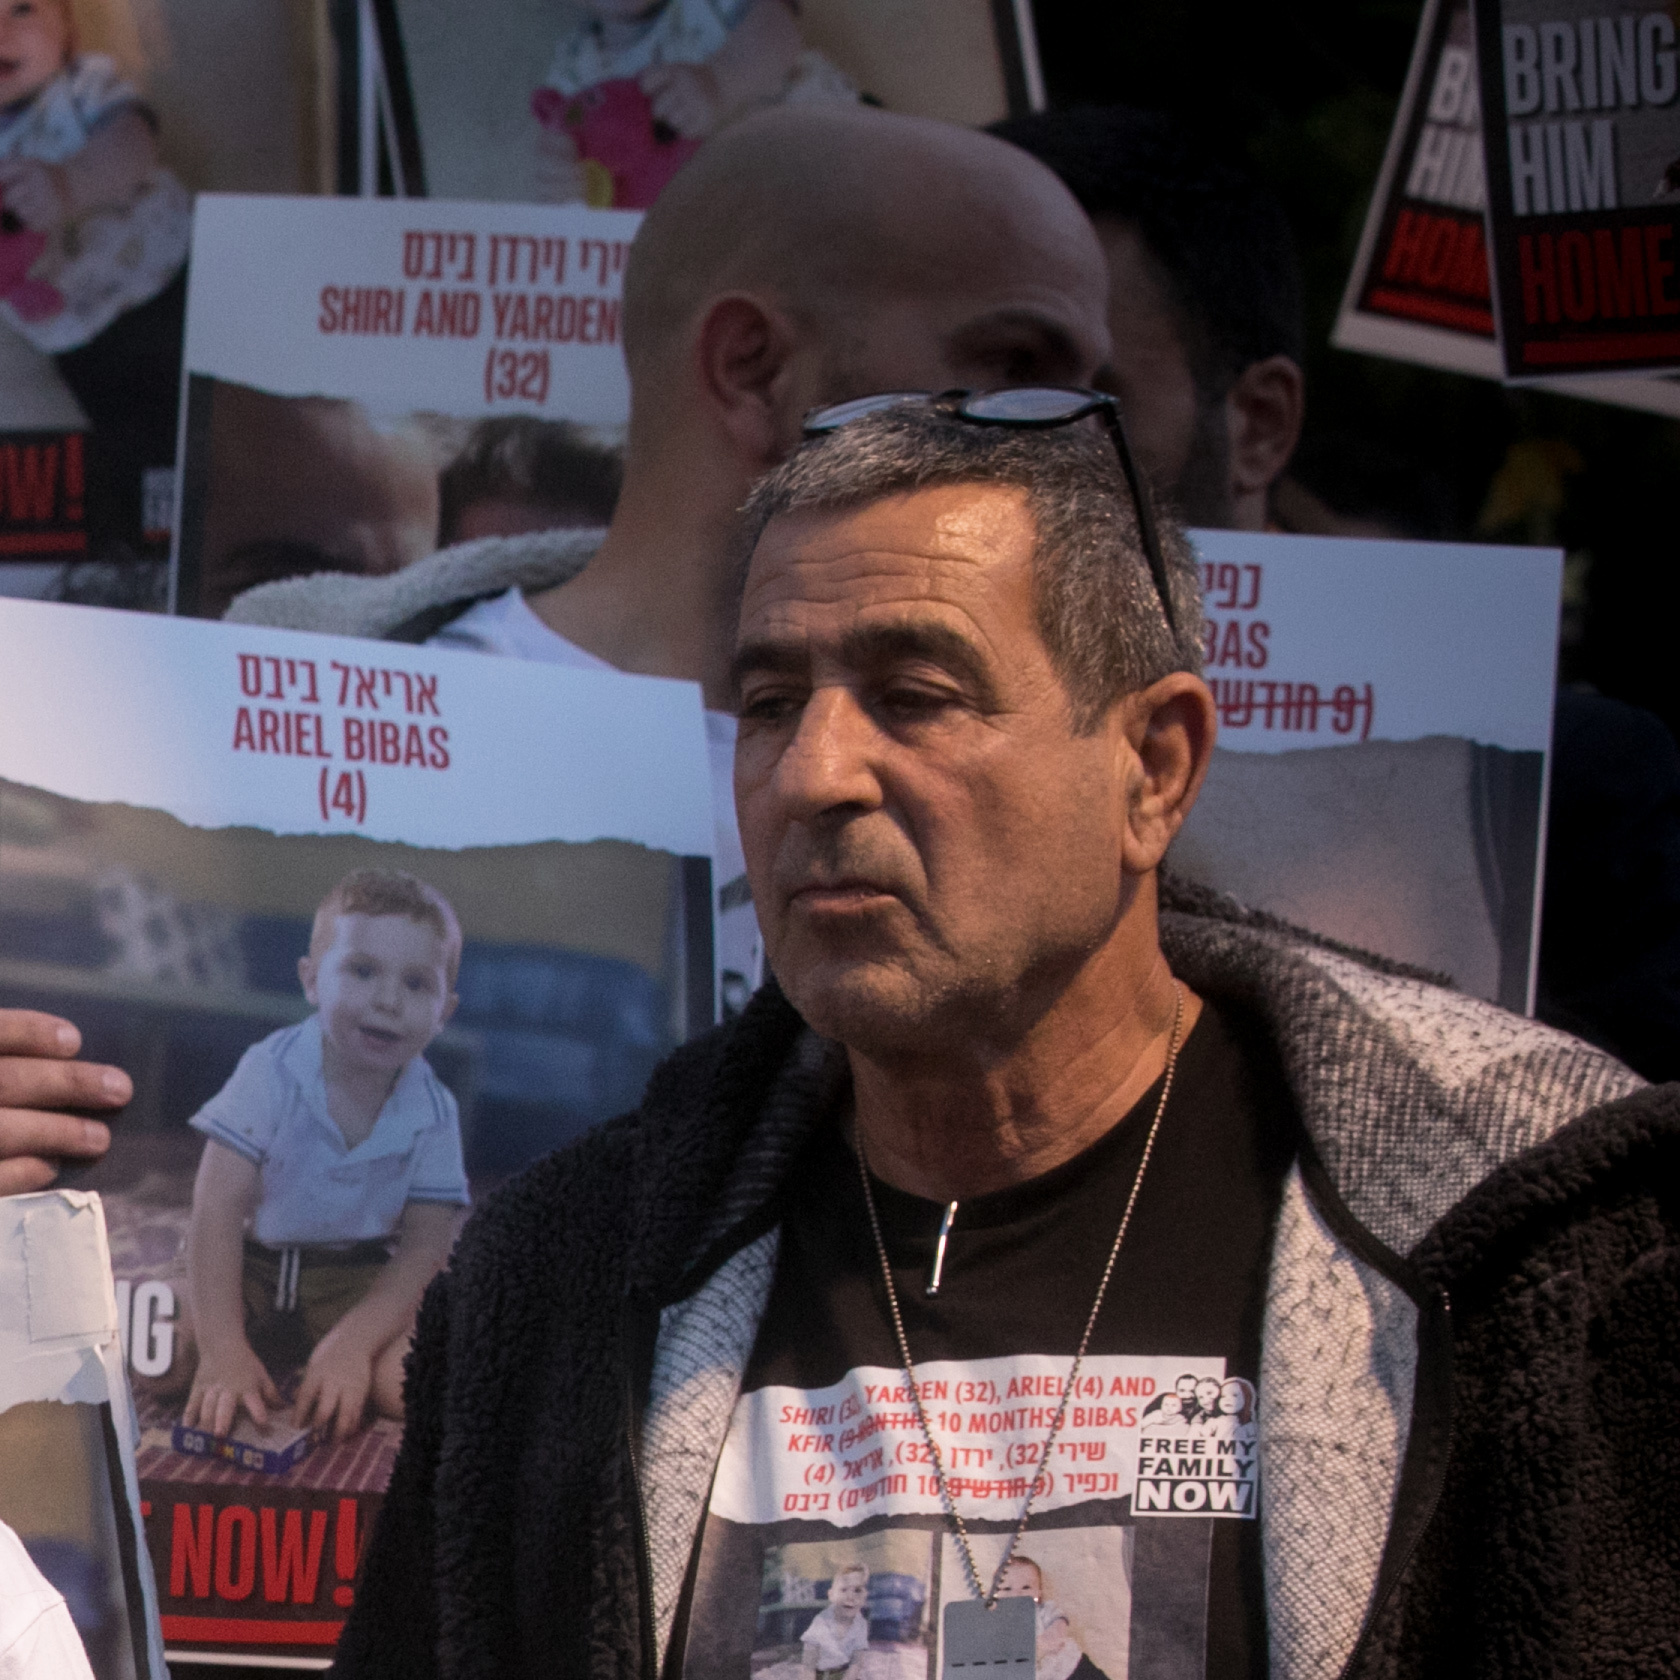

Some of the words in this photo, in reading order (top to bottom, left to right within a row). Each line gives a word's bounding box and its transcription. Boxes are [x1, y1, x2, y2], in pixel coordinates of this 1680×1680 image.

[1502, 12, 1677, 117] BRING
[1509, 118, 1618, 217] HIM
[402, 230, 477, 283] ביבס
[1518, 223, 1680, 325] HOME
[318, 285, 406, 336] SHIRI
[413, 288, 482, 339] AND
[492, 292, 622, 345] YARDEN
[484, 347, 551, 405] (32)
[1199, 562, 1262, 611] כפי
[1201, 620, 1271, 670] BAS
[237, 652, 320, 704] ביבס
[330, 659, 441, 718] אריאל
[233, 706, 333, 760] ARIEL
[343, 716, 451, 771] BIBAS
[317, 765, 367, 826] (4)
[779, 1404, 836, 1426] SHIRI
[1007, 1376, 1065, 1399] ARIEL
[1075, 1376, 1104, 1400] (4)
[1110, 1376, 1156, 1398] AND
[788, 1433, 835, 1453] KFIR
[938, 1411, 961, 1433] 10
[1073, 1407, 1139, 1428] BIBAS
[1058, 1441, 1107, 1463] שירי
[1139, 1438, 1206, 1455] FREE
[1217, 1439, 1257, 1456] MY
[804, 1463, 835, 1487] (4)
[1137, 1457, 1255, 1479] FAMILY
[784, 1493, 831, 1512] ביבס
[1137, 1480, 1252, 1511] NOW
[170, 1498, 365, 1607] NOW!
